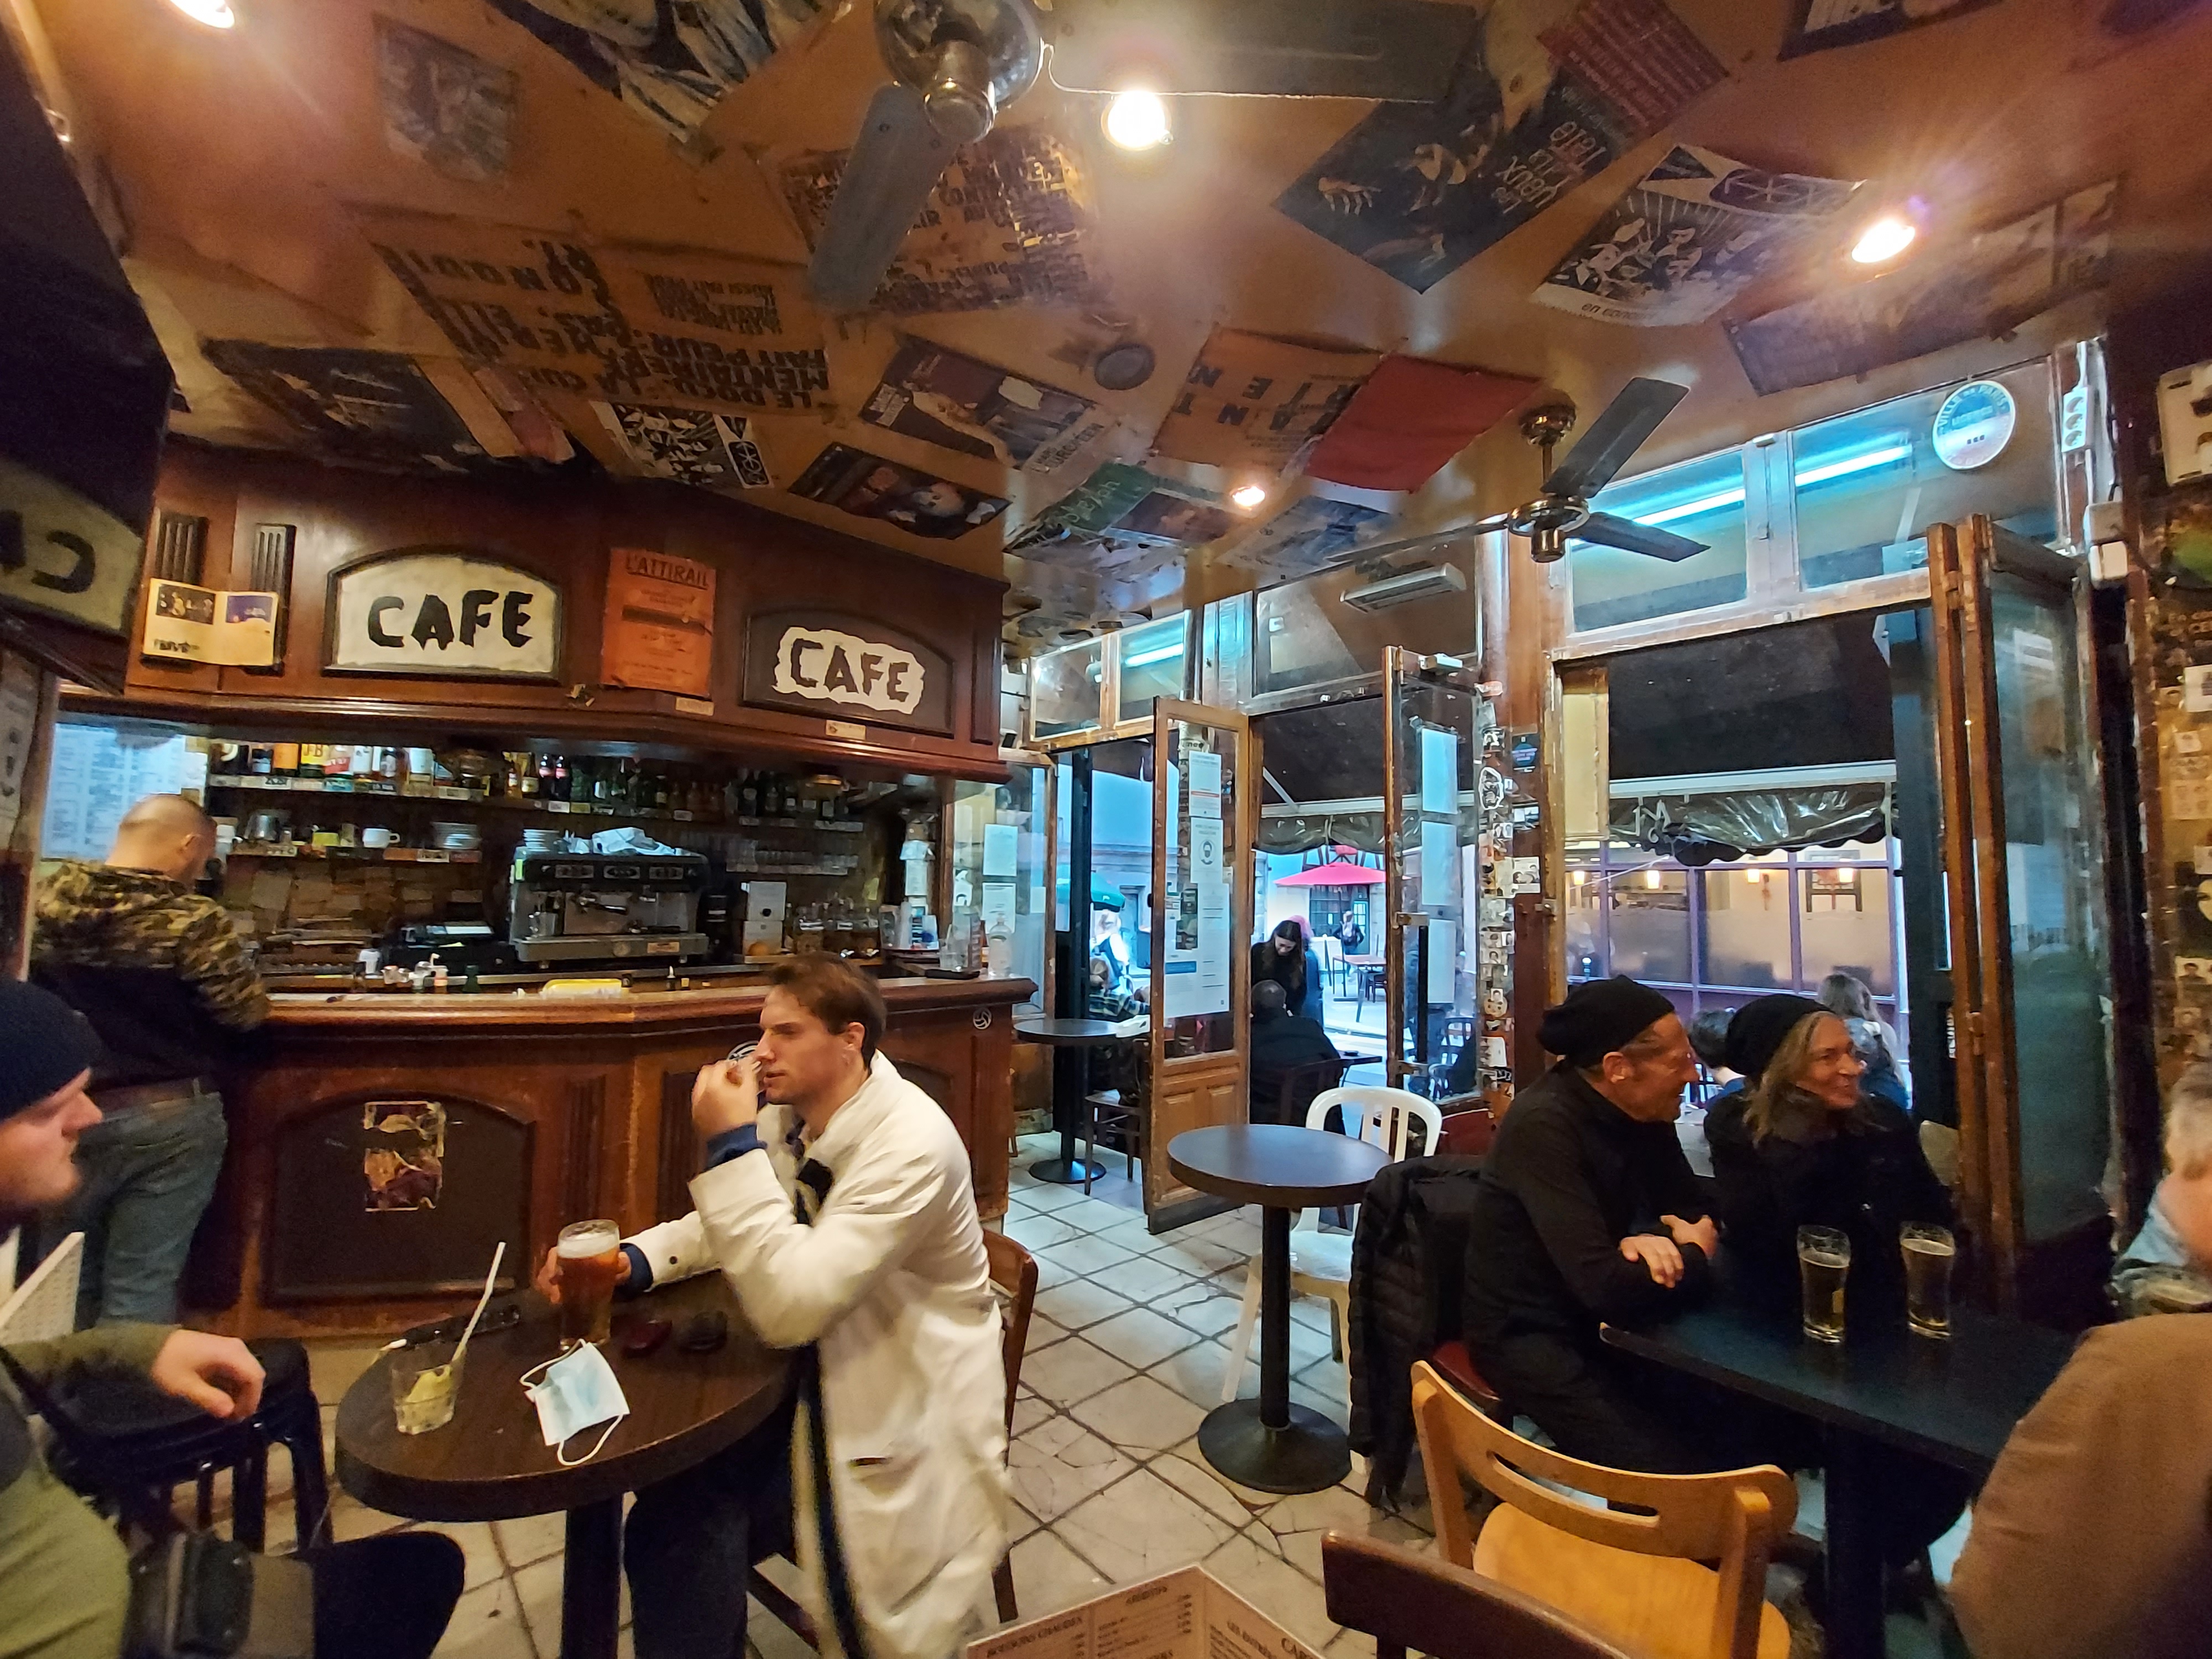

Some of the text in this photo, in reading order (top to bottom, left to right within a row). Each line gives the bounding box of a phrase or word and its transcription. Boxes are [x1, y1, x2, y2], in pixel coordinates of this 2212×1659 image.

[774, 389, 812, 409] LE
[1938, 395, 1963, 427] VILLE
[1978, 385, 2008, 407] PARIS
[625, 554, 709, 587] L'ATTIRAIL
[368, 590, 534, 651] CAFE
[790, 638, 911, 702] CAFE
